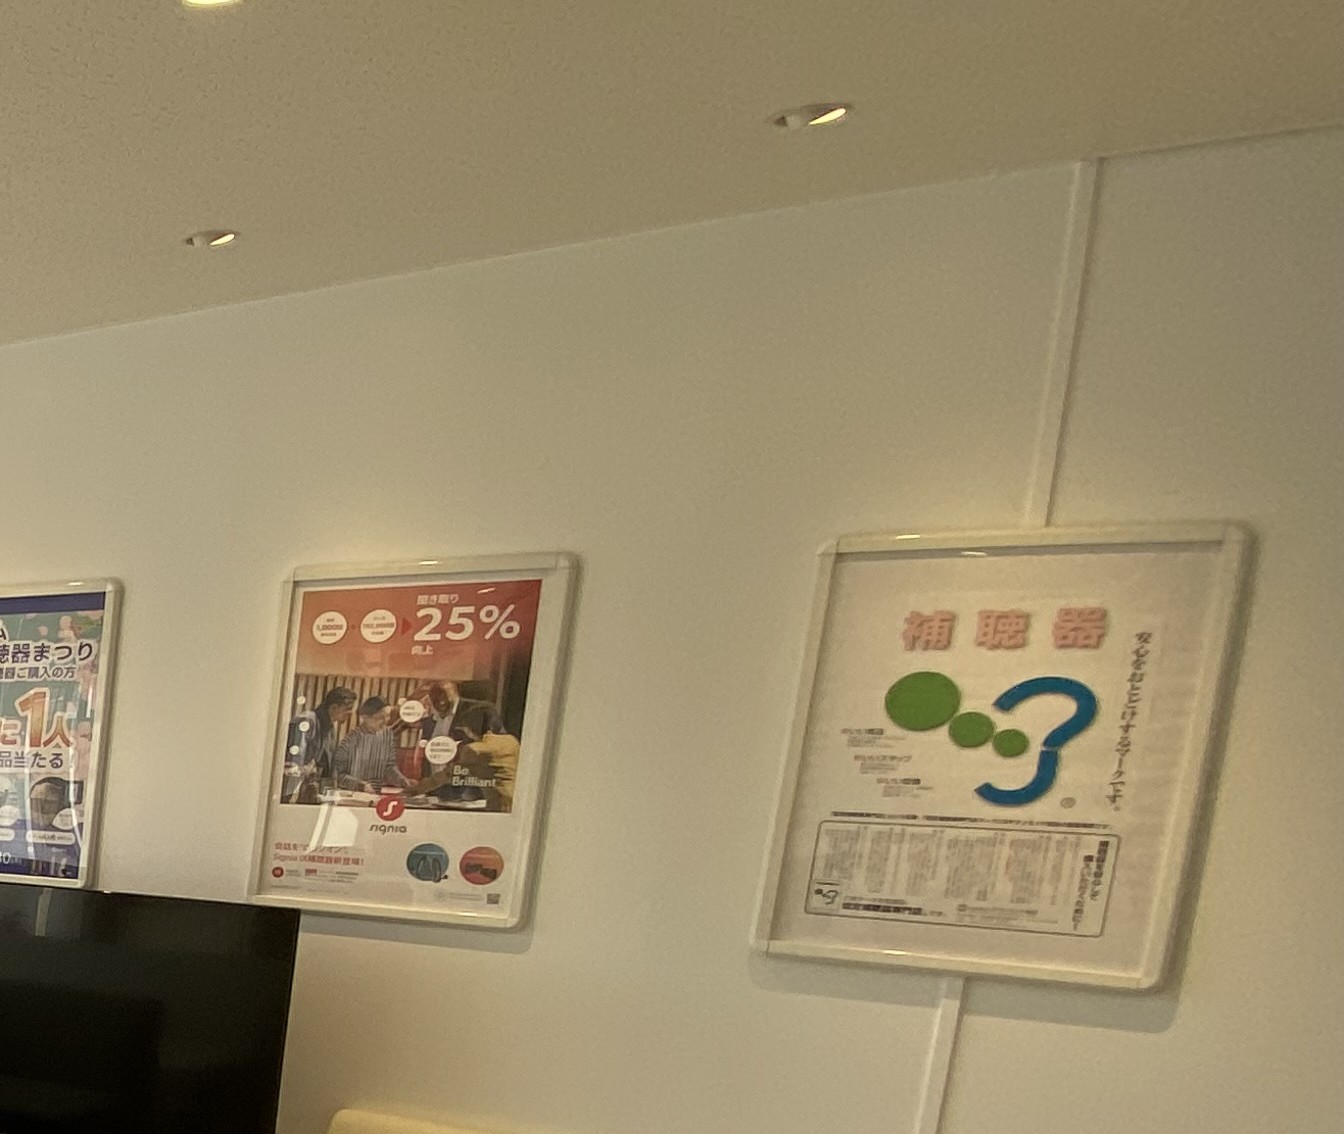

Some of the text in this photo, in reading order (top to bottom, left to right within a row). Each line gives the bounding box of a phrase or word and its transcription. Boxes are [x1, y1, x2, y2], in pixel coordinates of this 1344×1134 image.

[414, 604, 520, 641] 25%
[902, 606, 1108, 652] 補聴器
[411, 645, 434, 656] 向上
[452, 776, 497, 787] Brilliant
[368, 823, 408, 835] signia
